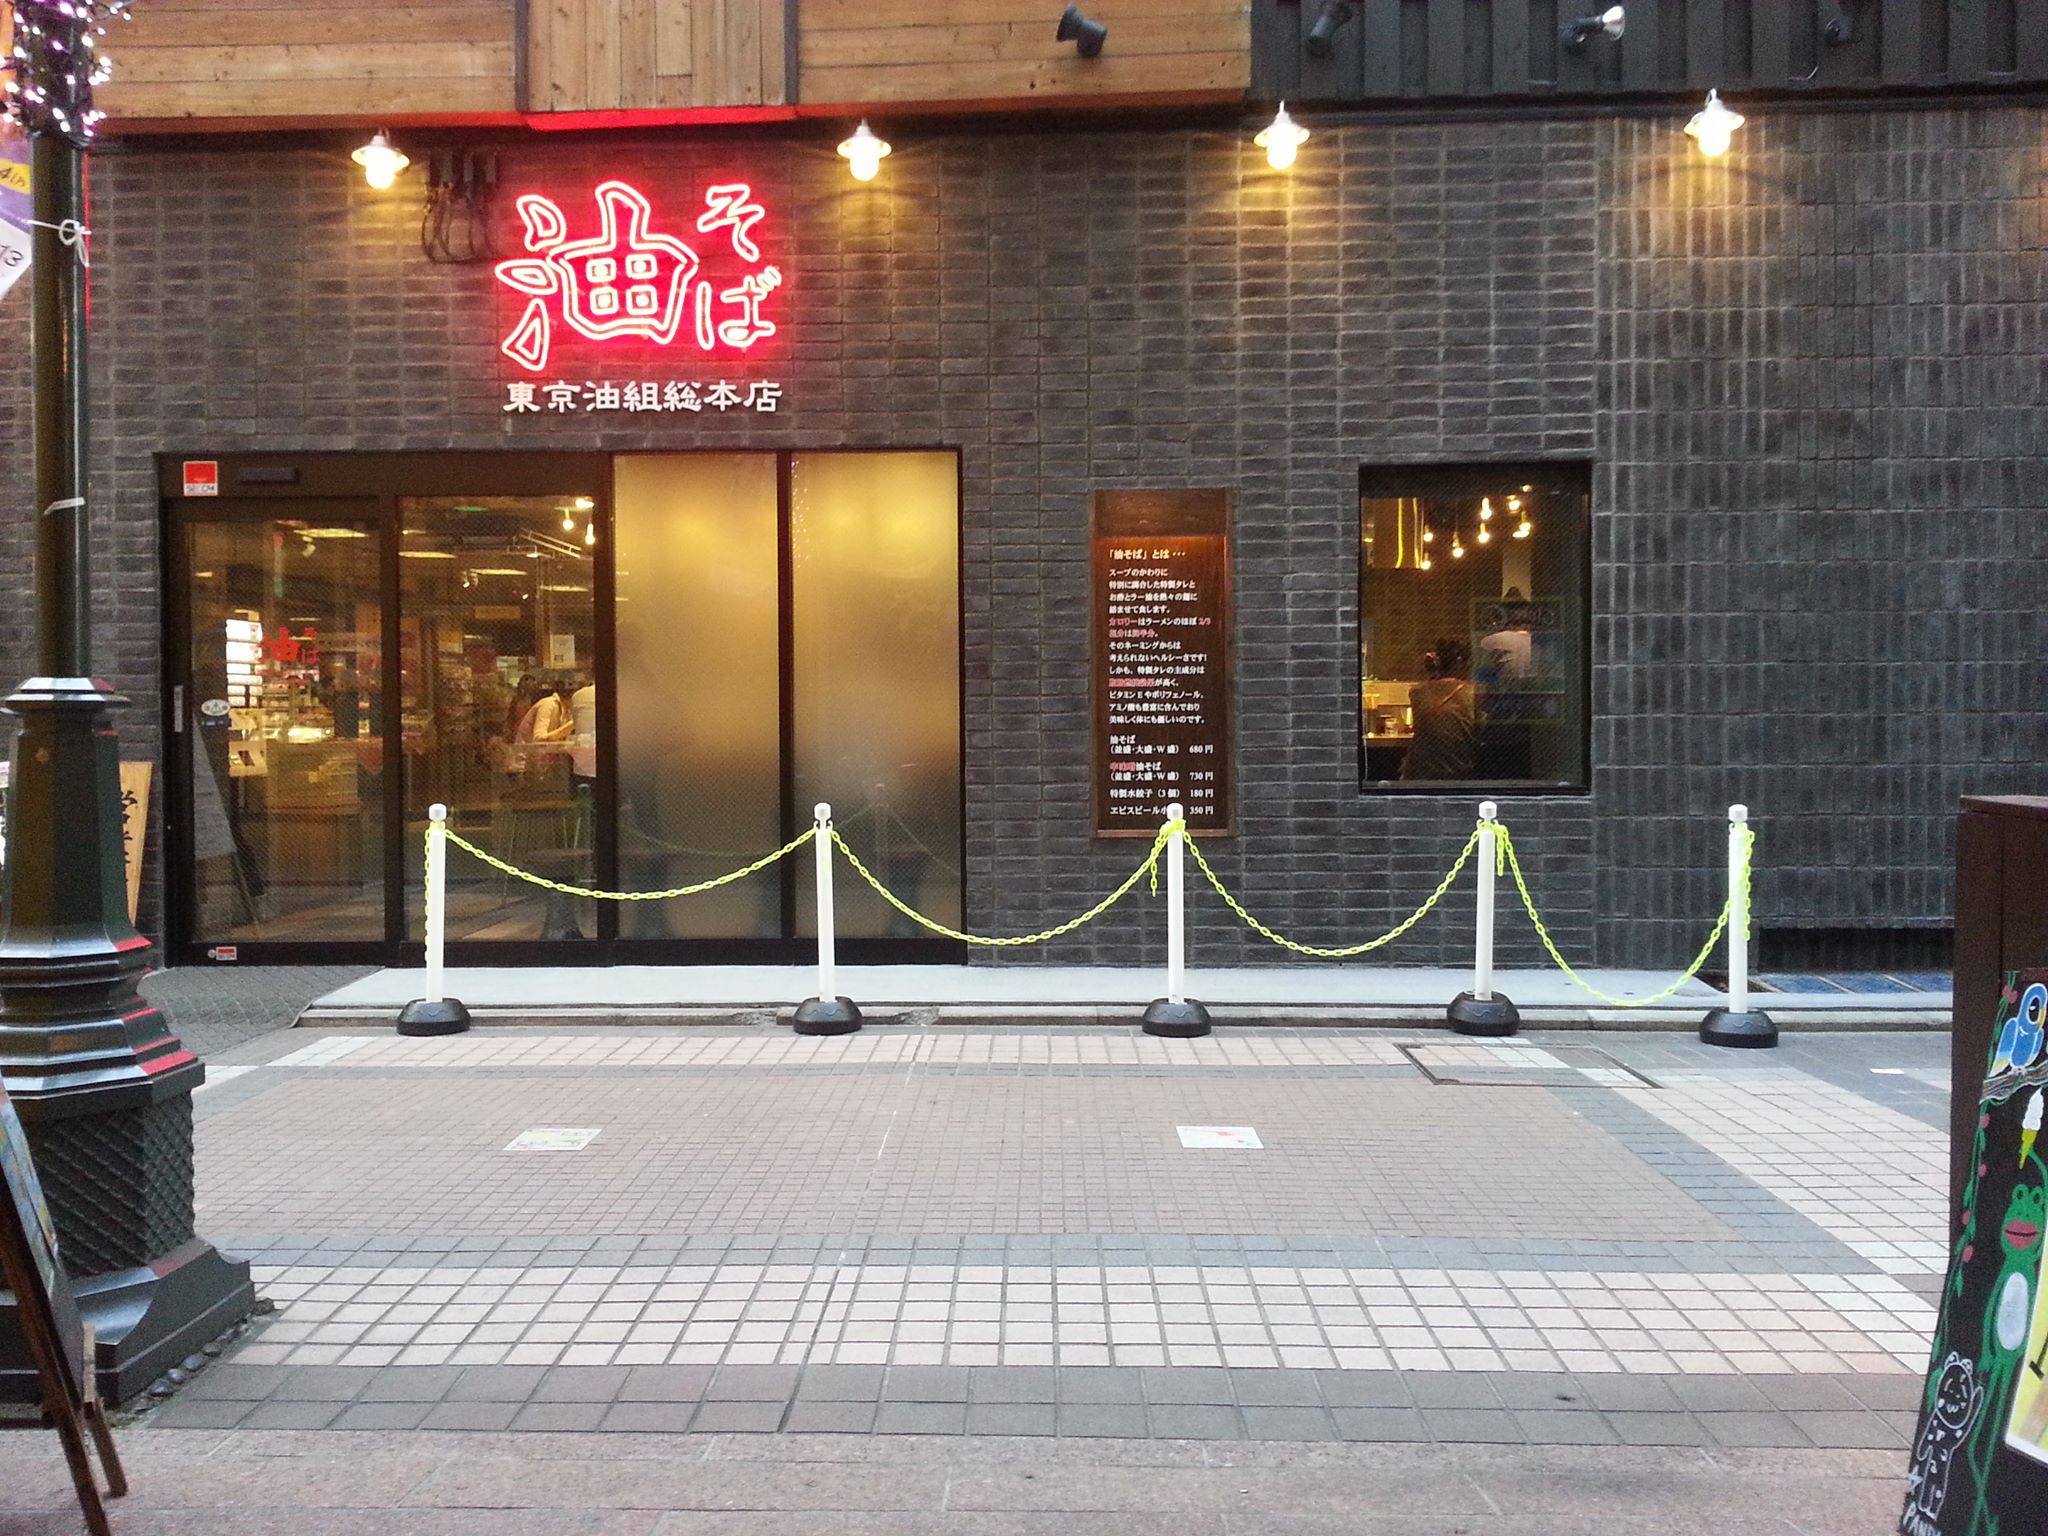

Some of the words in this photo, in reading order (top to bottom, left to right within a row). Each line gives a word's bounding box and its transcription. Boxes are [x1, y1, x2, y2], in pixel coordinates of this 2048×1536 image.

[494, 179, 783, 372] 油そば
[502, 379, 783, 413] 東京油組総本店
[1108, 568, 1169, 577] スープのかわりに
[1108, 579, 1196, 590] 特別に調合した特製タレと
[1108, 641, 1181, 650] そのネーミングからは
[1109, 703, 1200, 712] アミノ酸も豊富に含んでおり
[1110, 735, 1136, 745] 油そば
